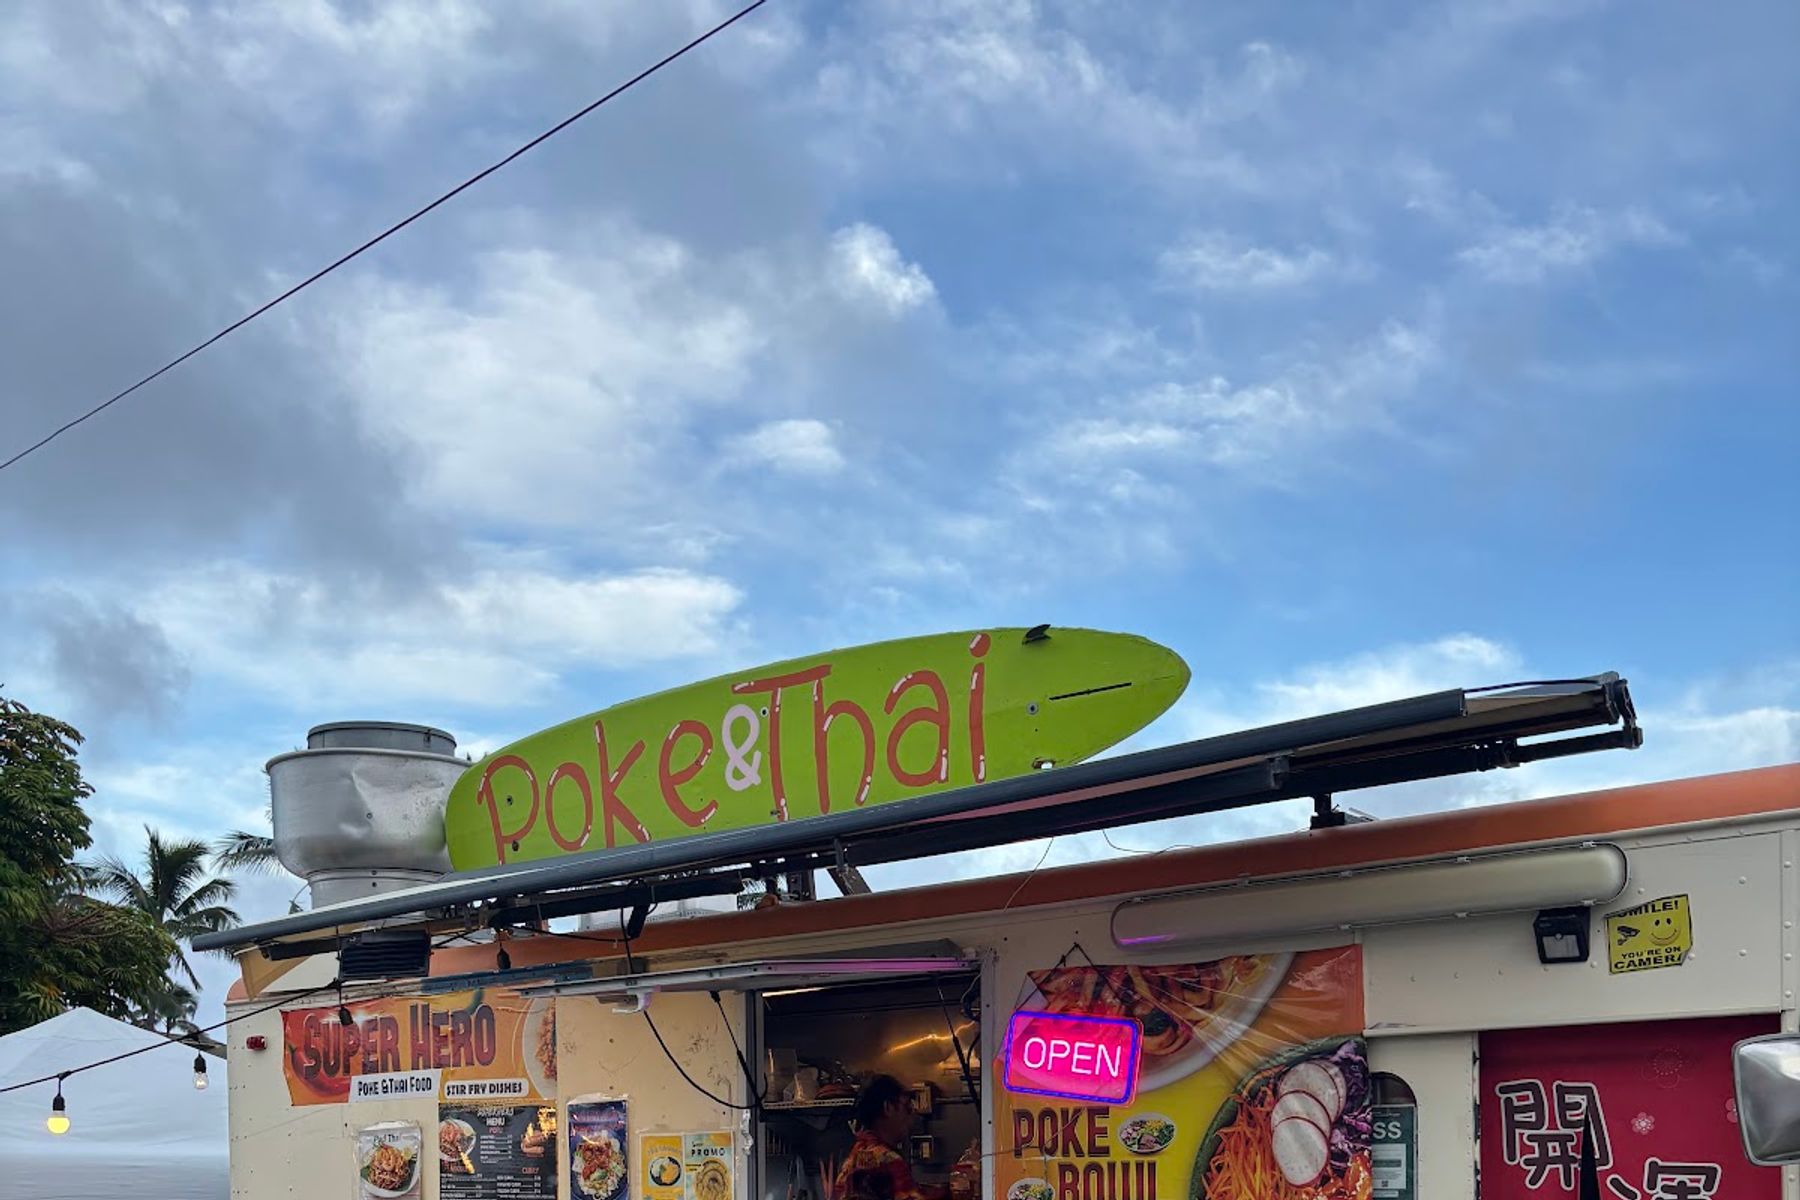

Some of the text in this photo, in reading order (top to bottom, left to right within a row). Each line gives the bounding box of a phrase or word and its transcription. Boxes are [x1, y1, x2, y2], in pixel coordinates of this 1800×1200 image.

[1621, 946, 1682, 959] YOU'RE ON
[303, 1002, 496, 1080] SUPER HERO
[1021, 1036, 1124, 1078] OPEN
[358, 1081, 379, 1096] POKE
[409, 1076, 432, 1092] FOOD
[446, 1082, 522, 1096] STIR FRY DISHES
[486, 1117, 505, 1127] MENU
[1372, 1121, 1402, 1139] SS
[1012, 1106, 1112, 1159] POKE
[691, 1148, 726, 1157] PROMO
